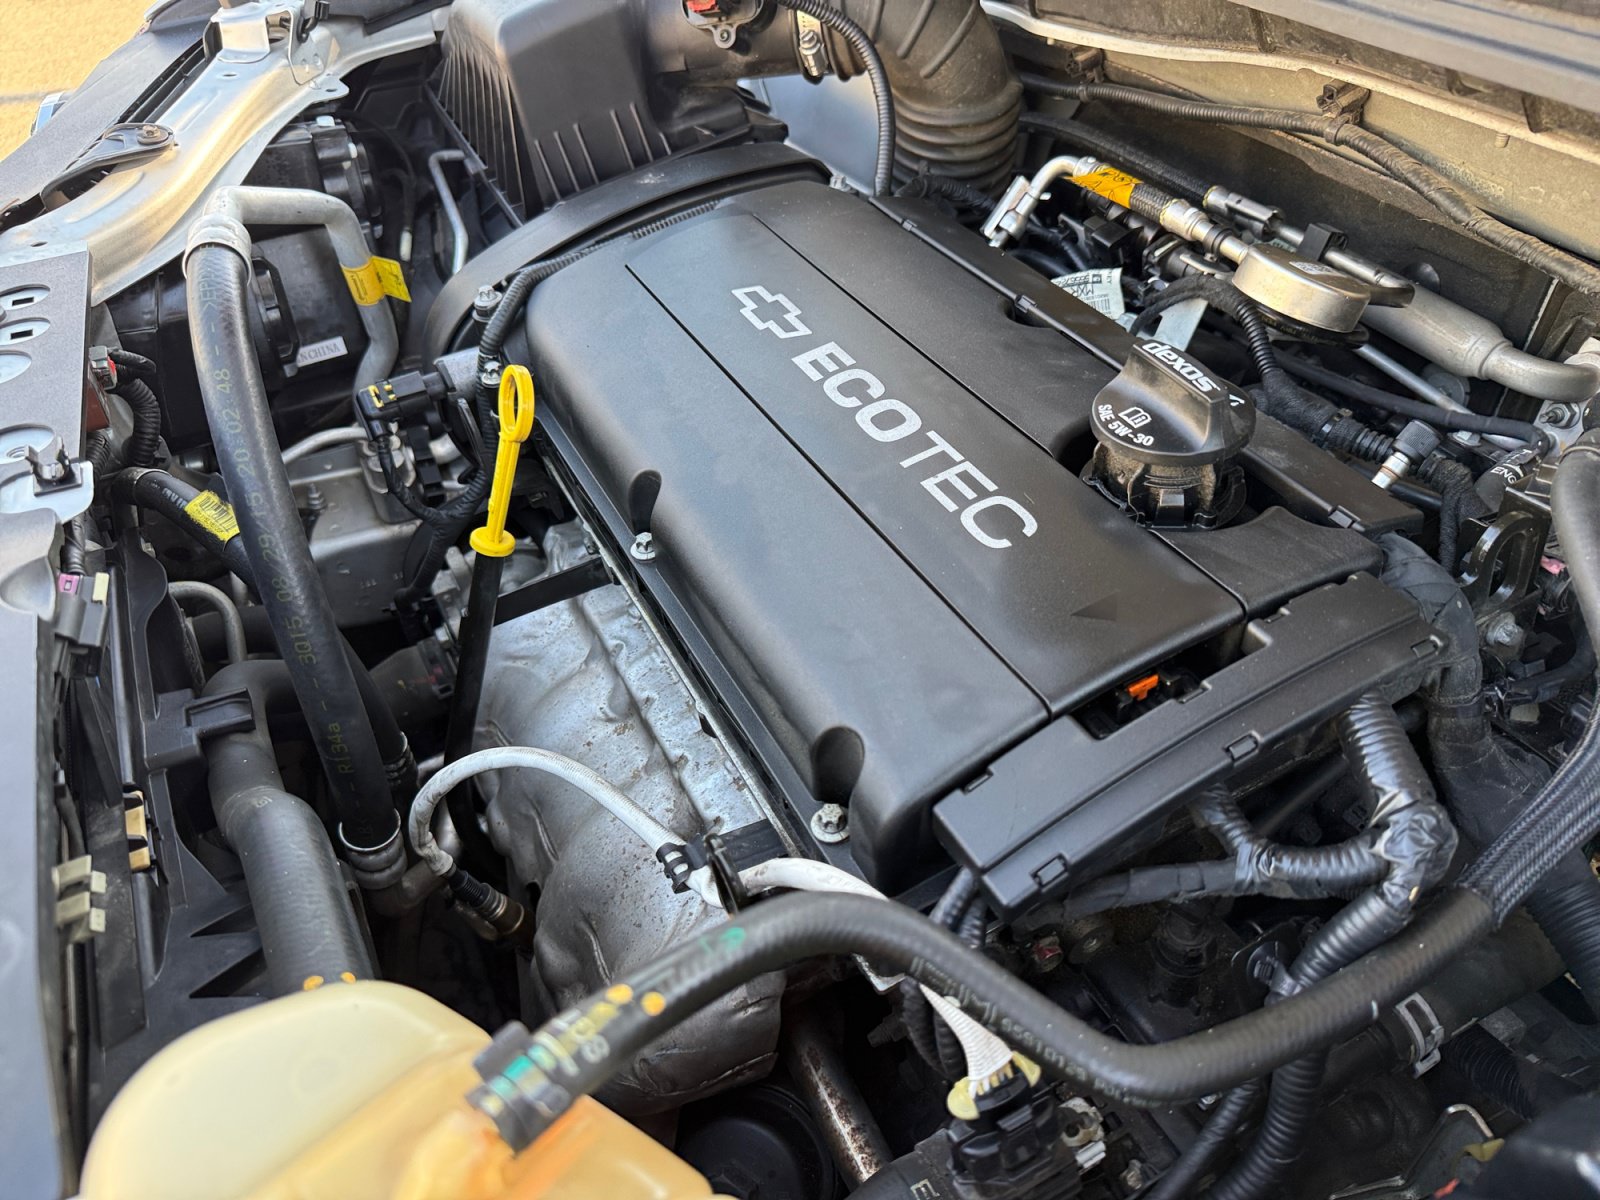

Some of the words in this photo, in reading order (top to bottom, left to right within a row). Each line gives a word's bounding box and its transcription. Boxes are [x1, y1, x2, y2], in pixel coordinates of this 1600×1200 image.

[1142, 342, 1221, 392] dexos
[791, 341, 1038, 549] ECOTEC
[1098, 404, 1115, 422] SAE
[1108, 420, 1154, 446] 5W-30
